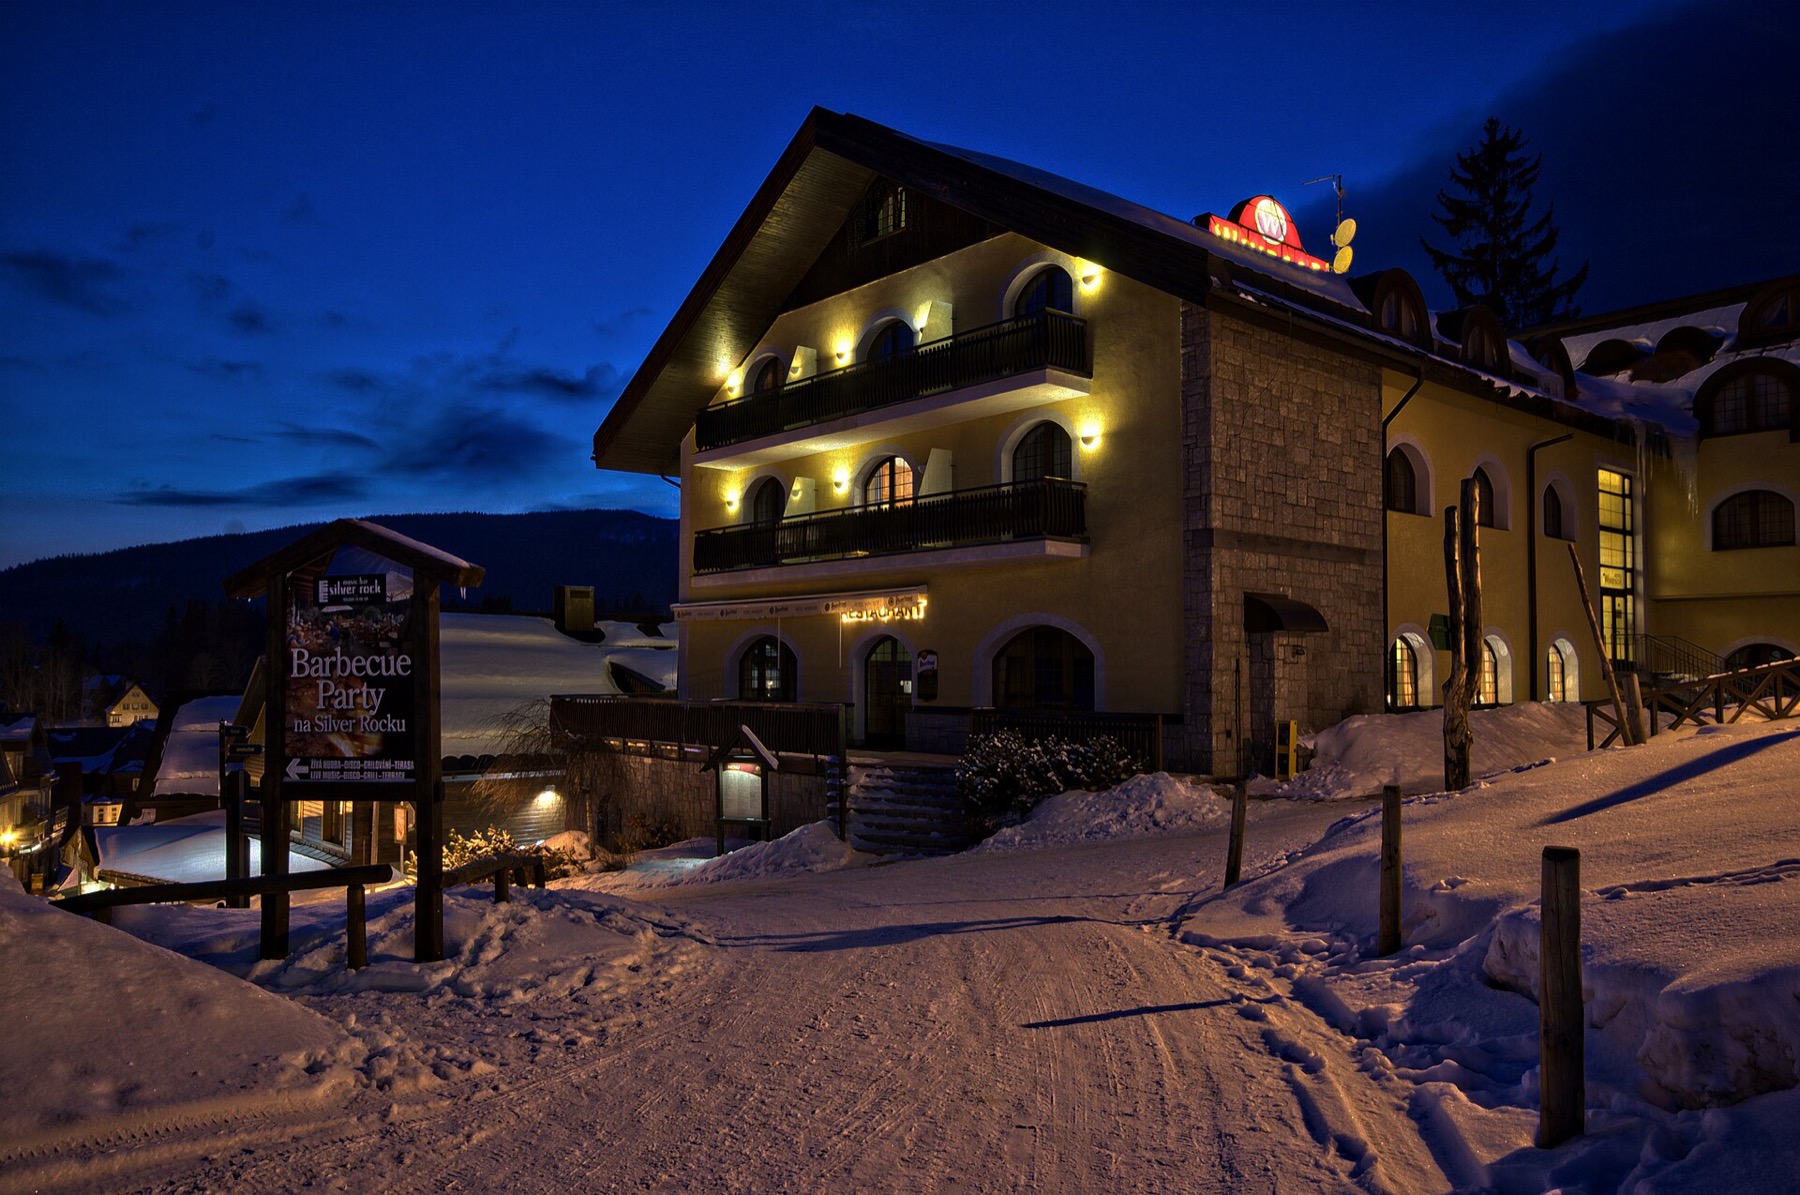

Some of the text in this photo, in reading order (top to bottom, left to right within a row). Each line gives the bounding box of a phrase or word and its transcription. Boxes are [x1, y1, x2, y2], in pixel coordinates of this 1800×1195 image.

[329, 579, 381, 595] silver rock
[290, 646, 412, 678] Barbecue
[316, 680, 386, 715] Party
[294, 713, 406, 733] na Silver Rocku
[310, 771, 321, 779] LIVE
